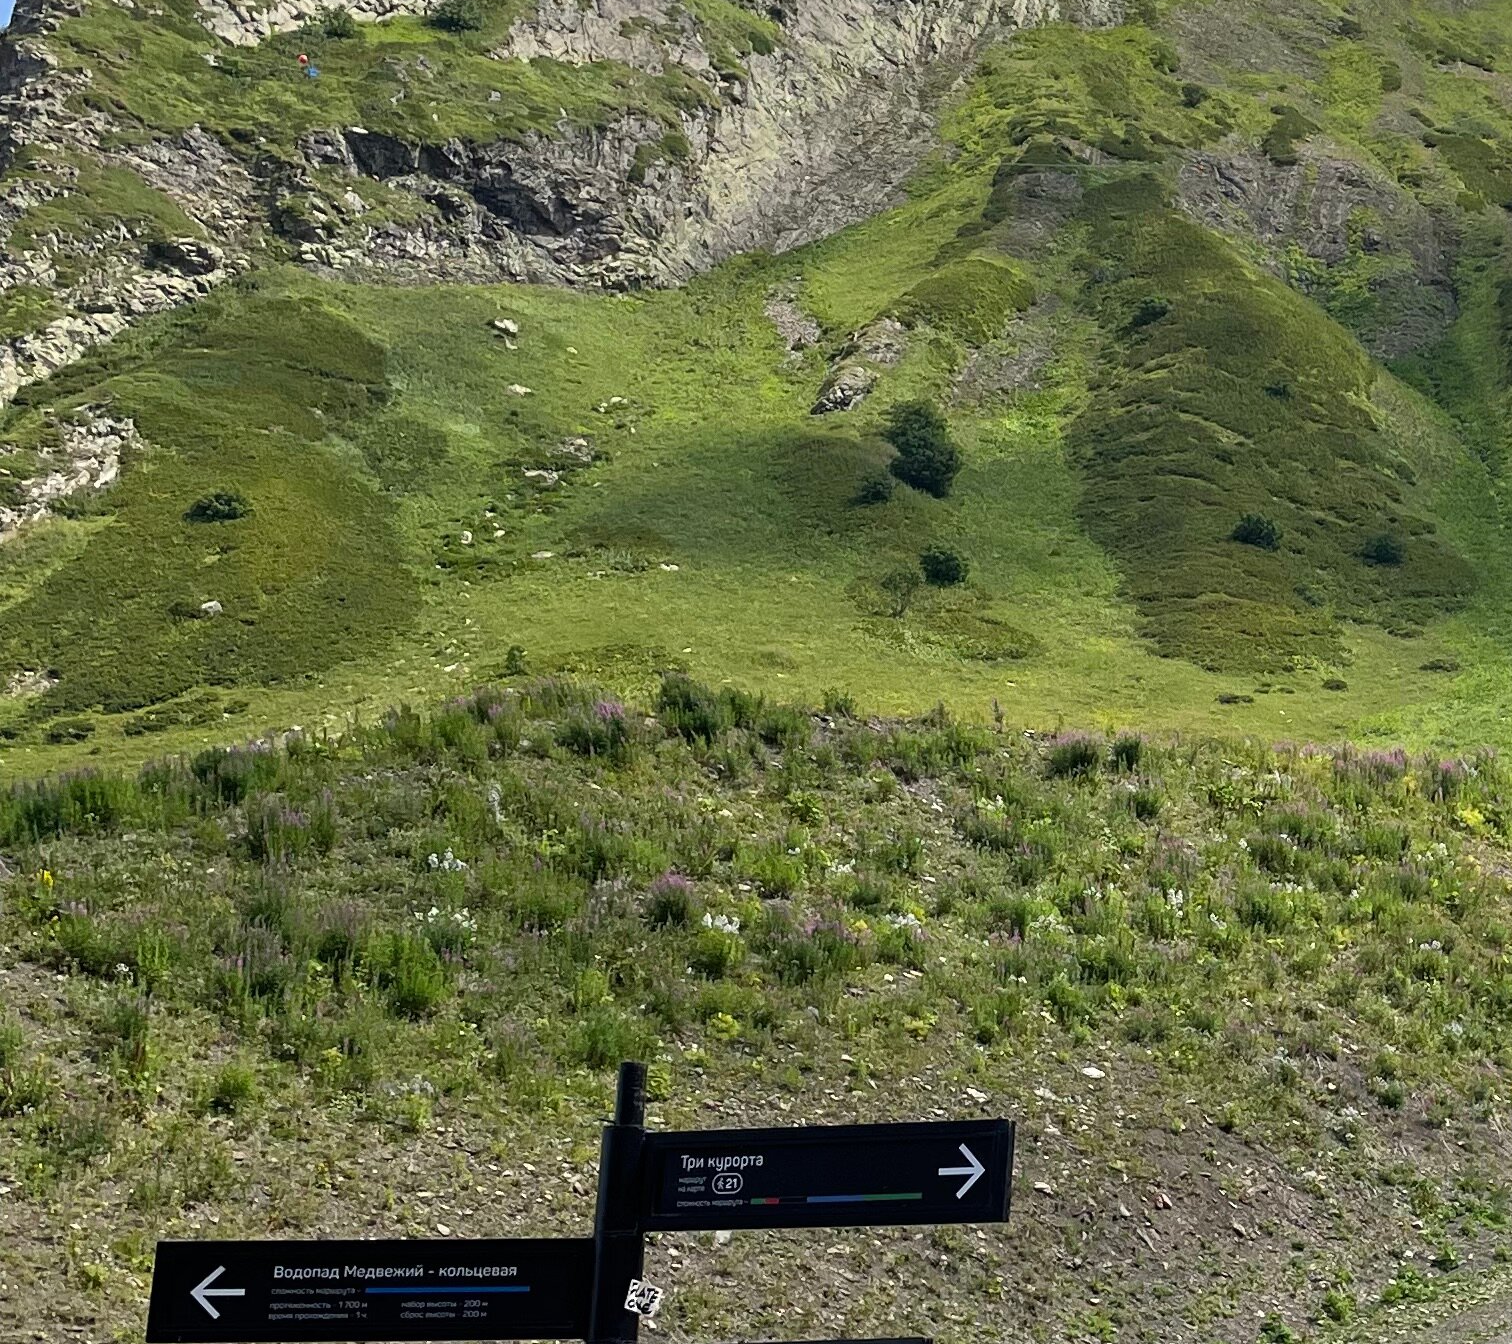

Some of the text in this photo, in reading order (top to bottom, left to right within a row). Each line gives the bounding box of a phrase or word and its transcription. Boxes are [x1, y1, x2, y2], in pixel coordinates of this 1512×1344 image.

[680, 1154, 764, 1172] Три курорта
[725, 1177, 738, 1189] 21
[273, 1265, 340, 1280] Водопад
[343, 1264, 424, 1279] Медвежий
[438, 1266, 518, 1278] кольцевая
